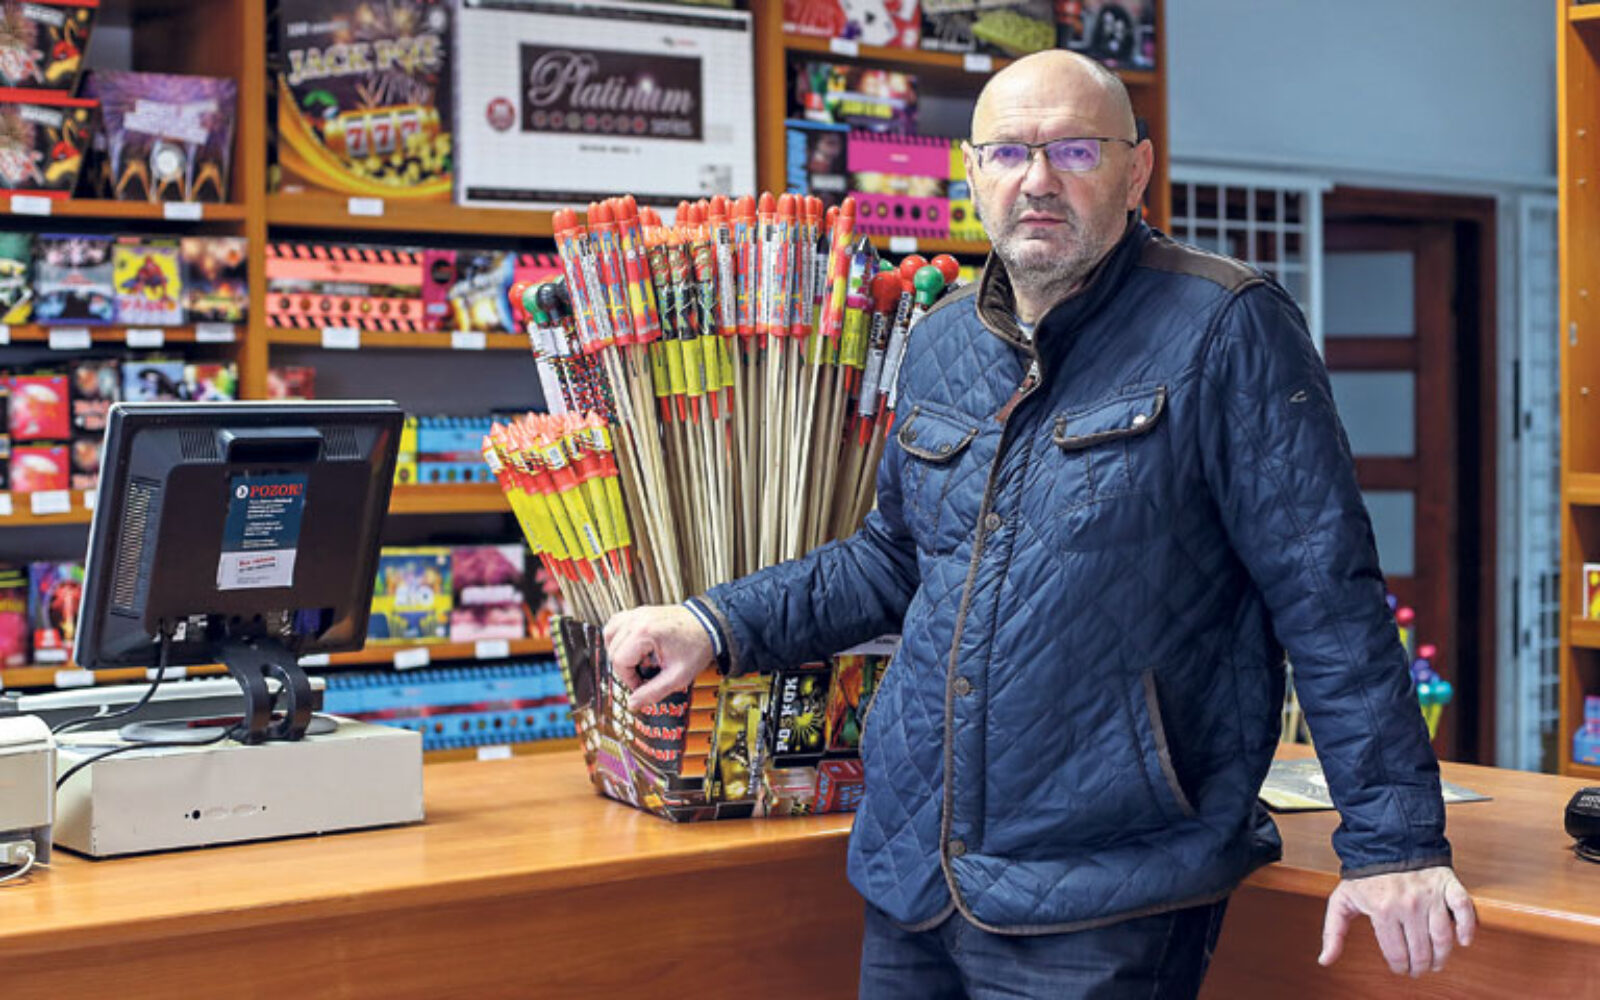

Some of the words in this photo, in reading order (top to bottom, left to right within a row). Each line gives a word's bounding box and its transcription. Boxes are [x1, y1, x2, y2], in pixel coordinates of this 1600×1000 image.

[288, 44, 373, 85] JACK
[373, 35, 440, 73] POT
[528, 51, 693, 115] Platinum
[249, 483, 304, 498] POZOR!
